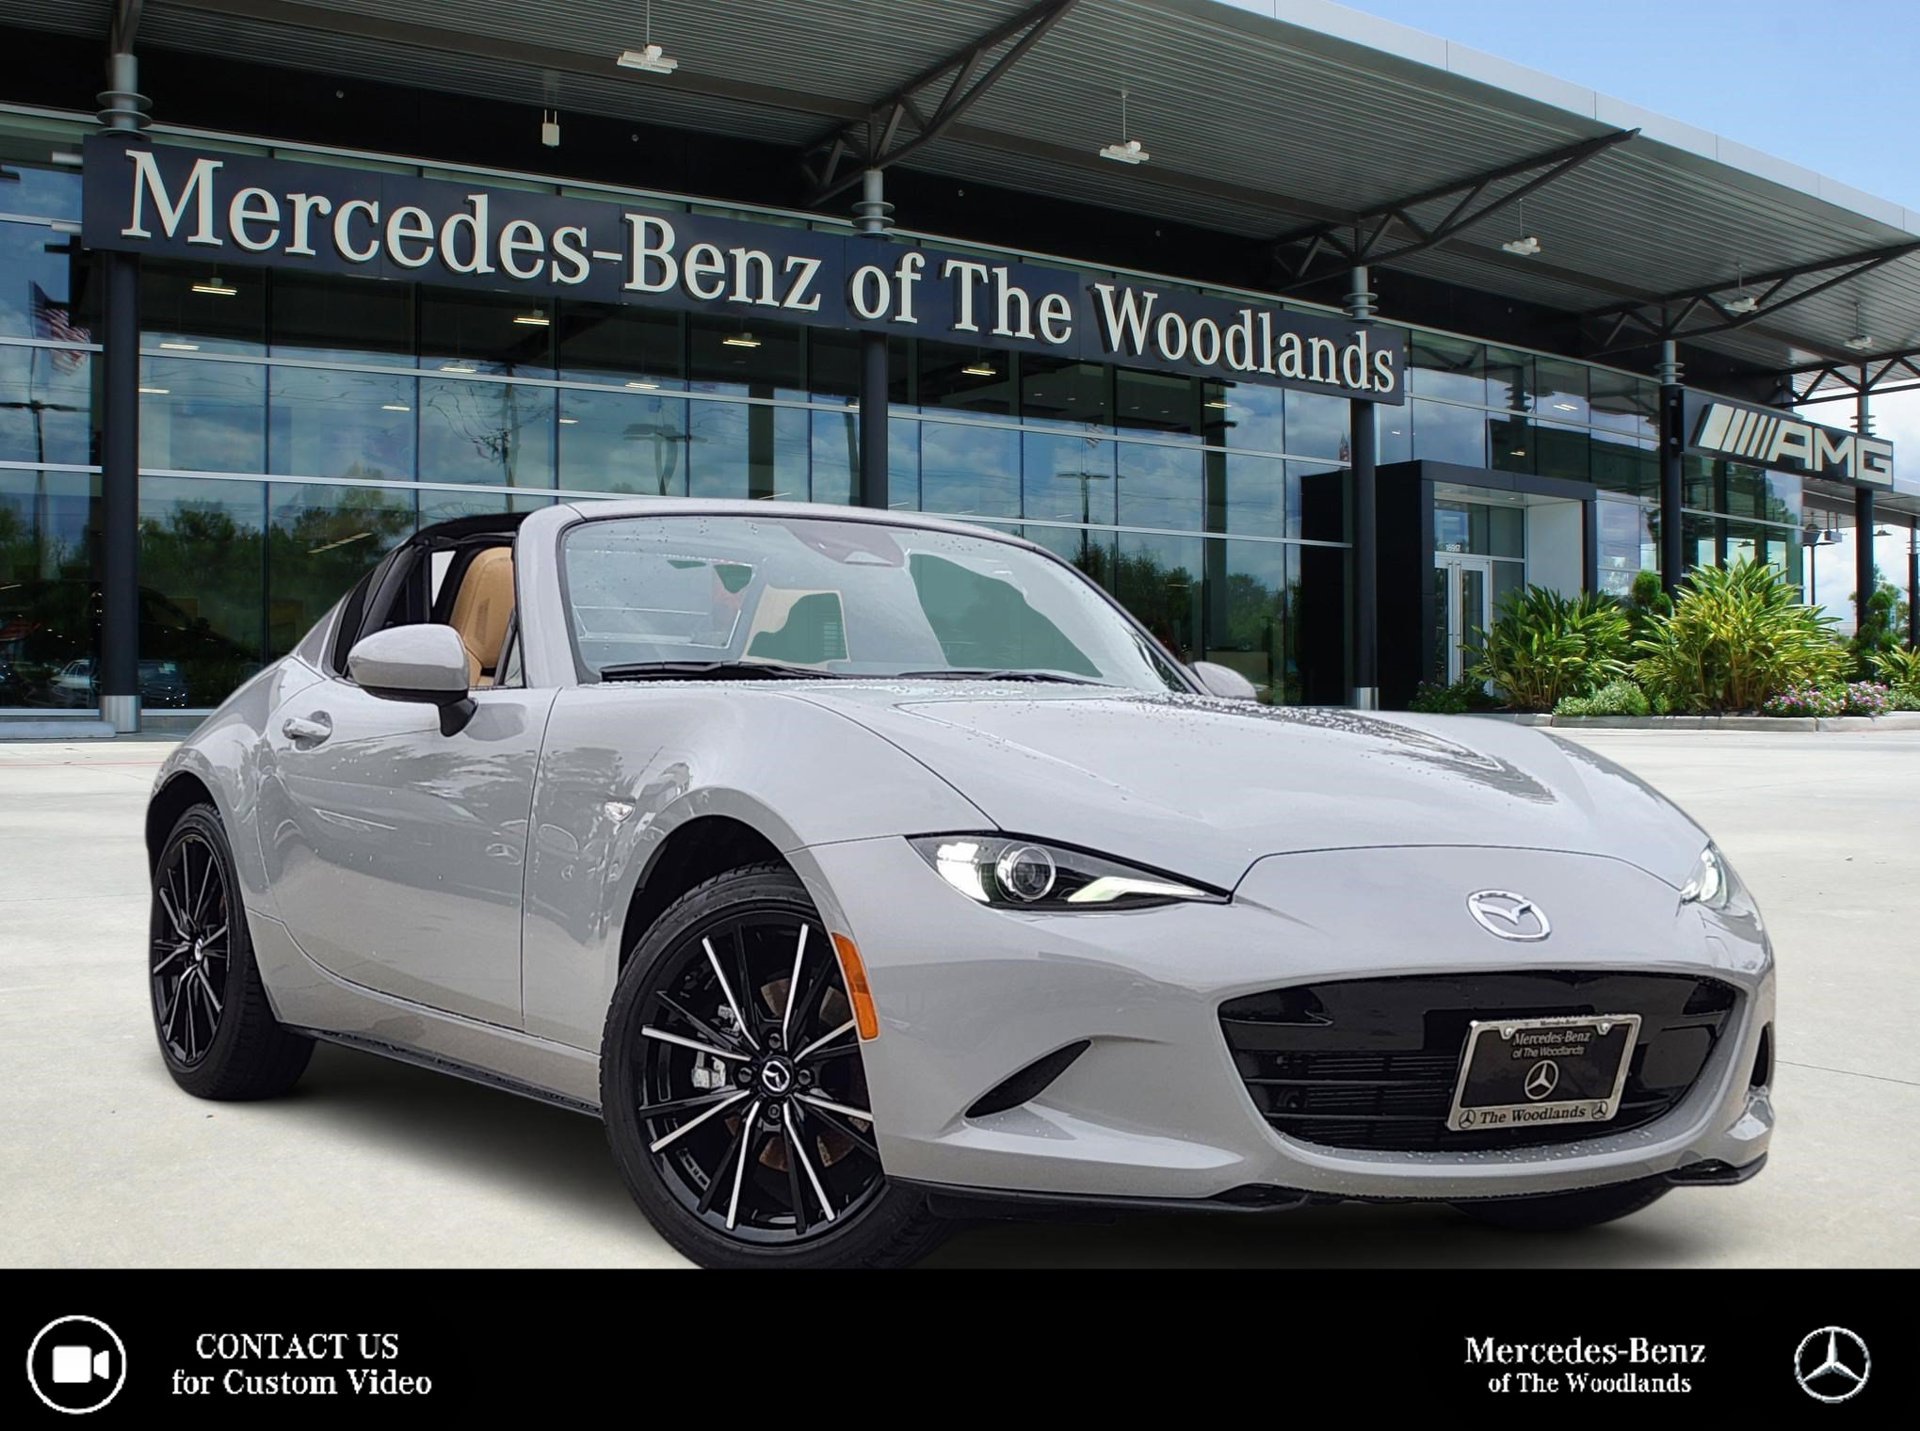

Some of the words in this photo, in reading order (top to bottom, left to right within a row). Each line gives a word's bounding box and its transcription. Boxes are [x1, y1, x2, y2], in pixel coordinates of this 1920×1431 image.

[121, 149, 822, 312] Mercedes-Benz
[848, 252, 926, 324] of
[944, 258, 1073, 346] The
[1092, 281, 1395, 394] Woodlands
[1512, 1030, 1591, 1046] Mercedes-Benz
[1512, 1047, 1523, 1058] of
[1523, 1047, 1539, 1058] The
[1540, 1045, 1585, 1057] Woodlands
[1480, 1111, 1506, 1124] The
[1512, 1105, 1587, 1122] Woodlands
